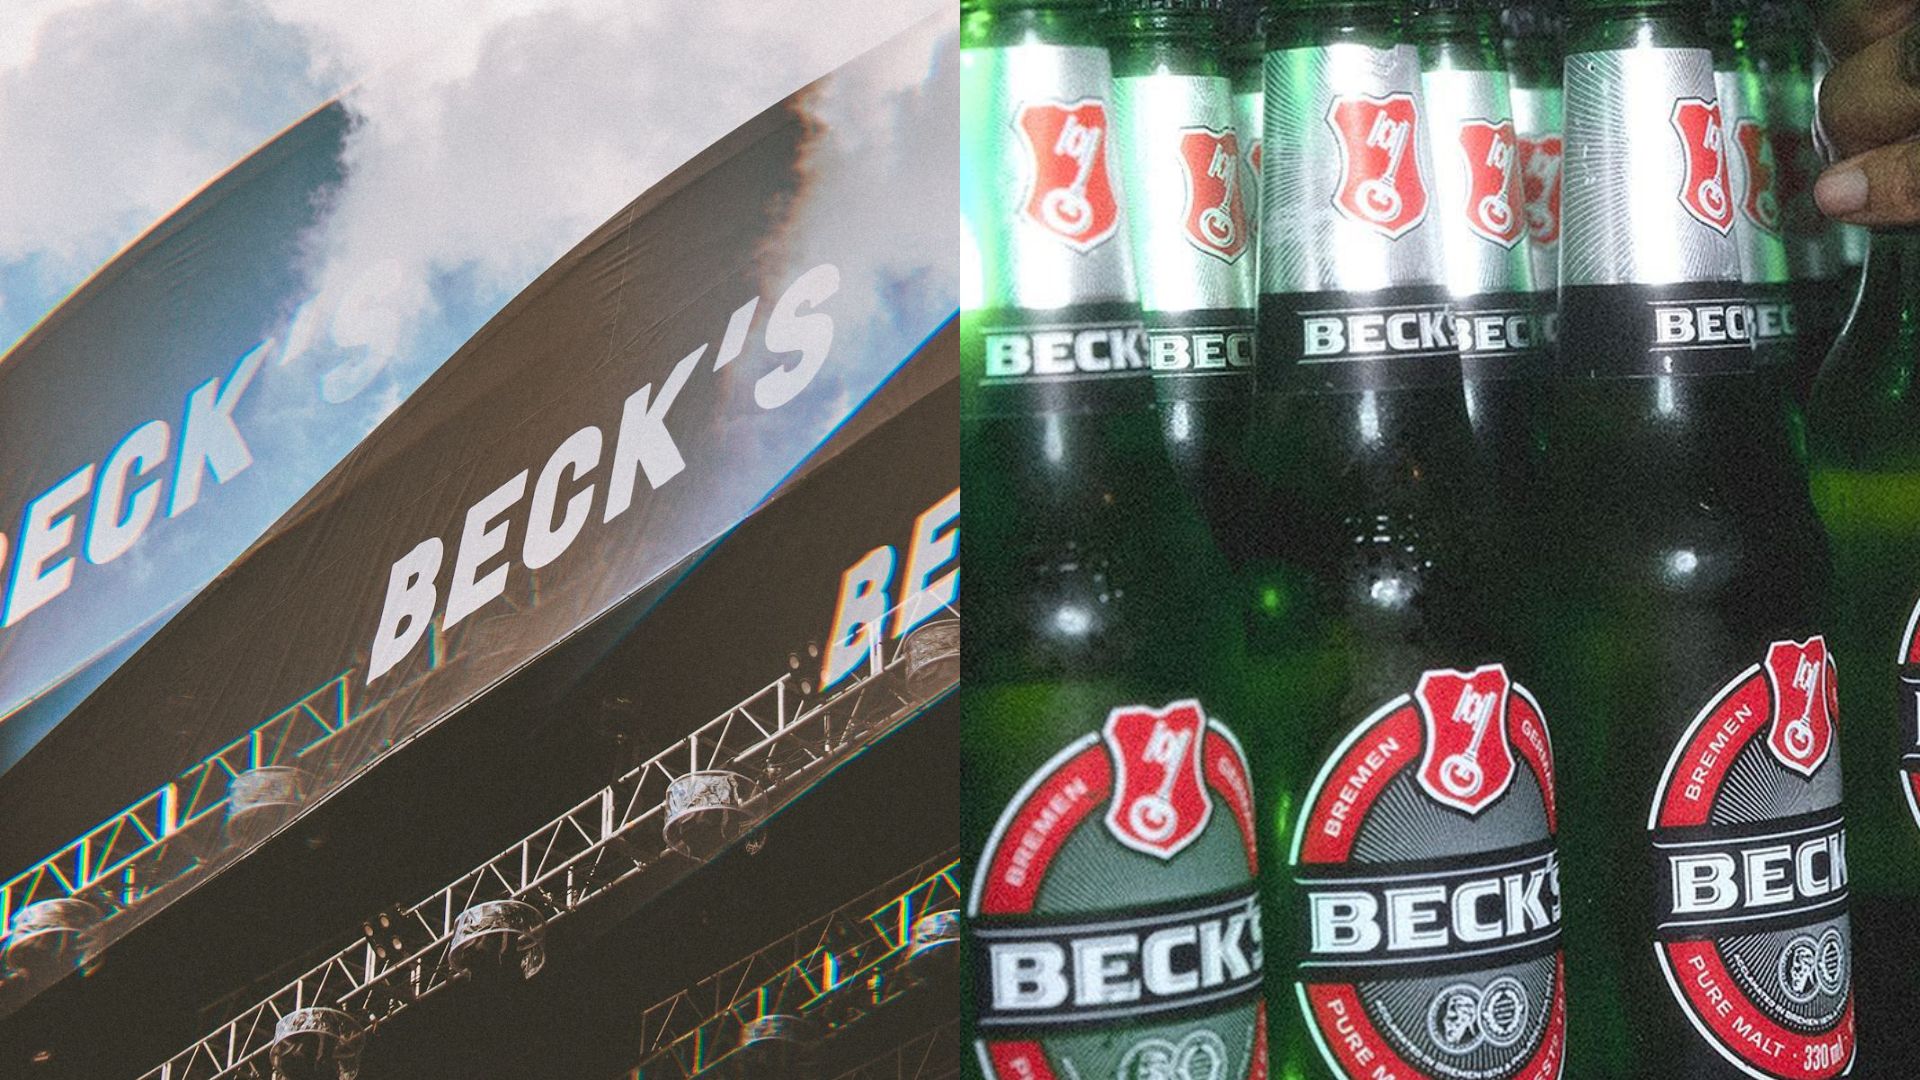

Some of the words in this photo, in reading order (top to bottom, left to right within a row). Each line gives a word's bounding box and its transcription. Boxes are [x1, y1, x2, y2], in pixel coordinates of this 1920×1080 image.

[1150, 333, 1256, 371] BEC
[0, 258, 403, 628] ECK'S
[366, 263, 841, 686] BECK'S
[1323, 736, 1399, 838] BREMEN
[1685, 703, 1753, 802] BREMEN
[1004, 777, 1089, 888] BREMEN
[1327, 998, 1375, 1068] PURE
[1688, 954, 1734, 1017] PURE
[1731, 1015, 1786, 1059] MALT
[1803, 1042, 1829, 1071] 330
